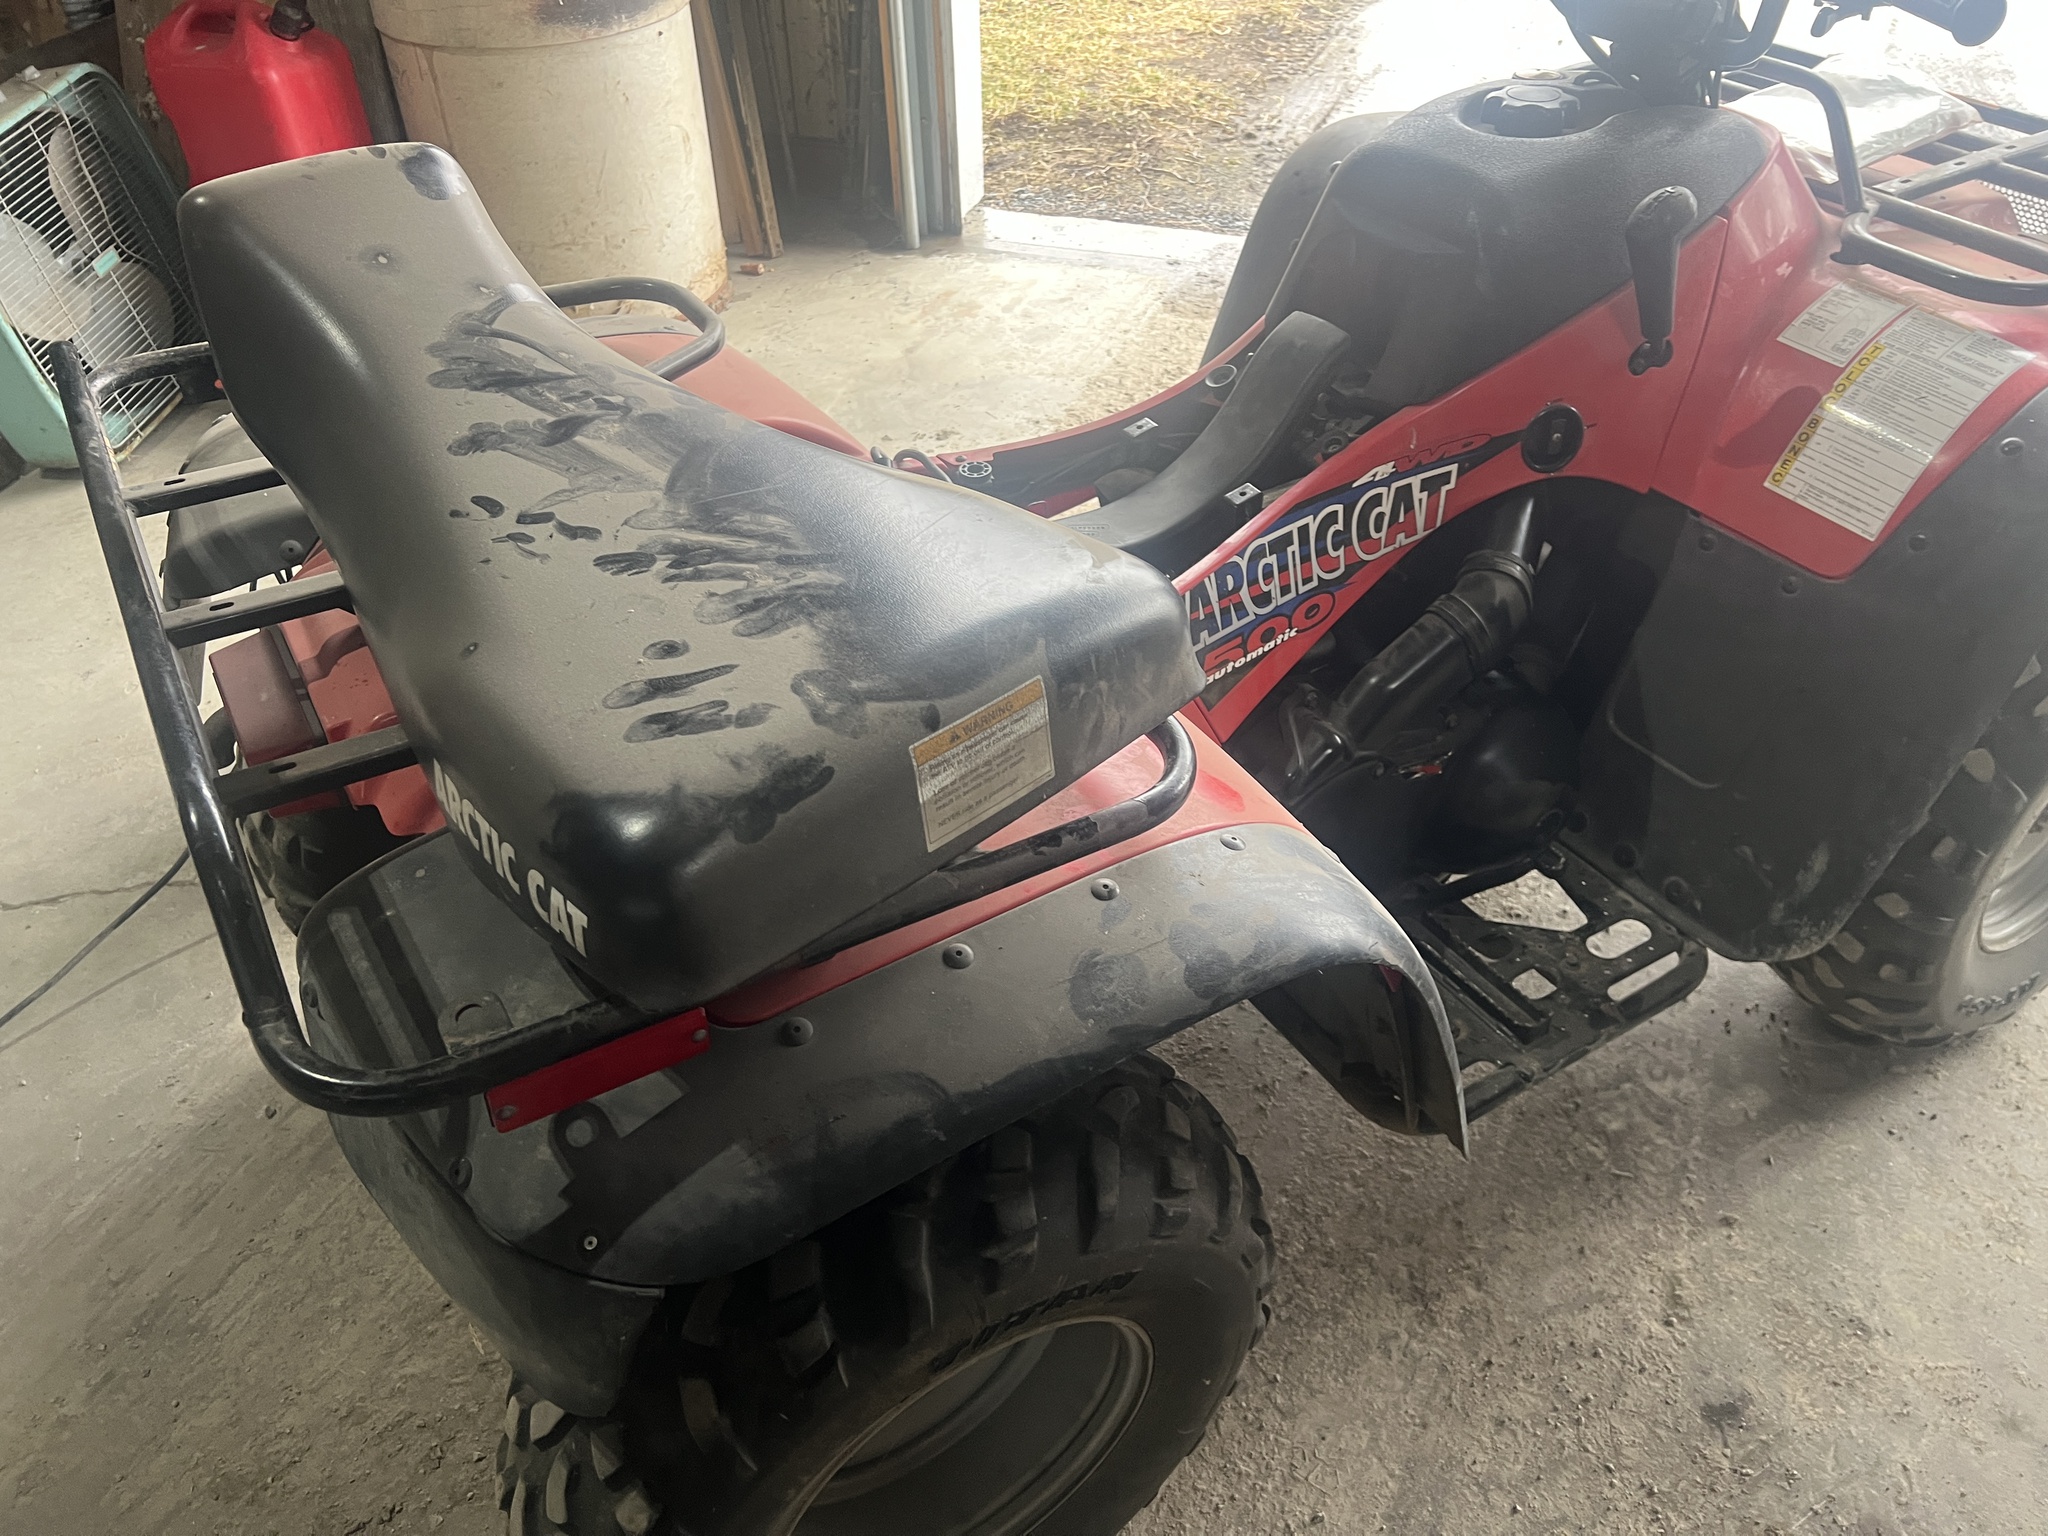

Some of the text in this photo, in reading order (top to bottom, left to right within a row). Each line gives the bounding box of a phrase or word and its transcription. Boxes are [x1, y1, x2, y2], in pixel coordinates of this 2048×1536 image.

[1184, 463, 1459, 652] ARCTIC CAT
[1204, 590, 1336, 677] 500
[1206, 626, 1299, 685] automatic
[962, 701, 1014, 736] WARNING
[433, 757, 589, 958] ARCTIC CAT
